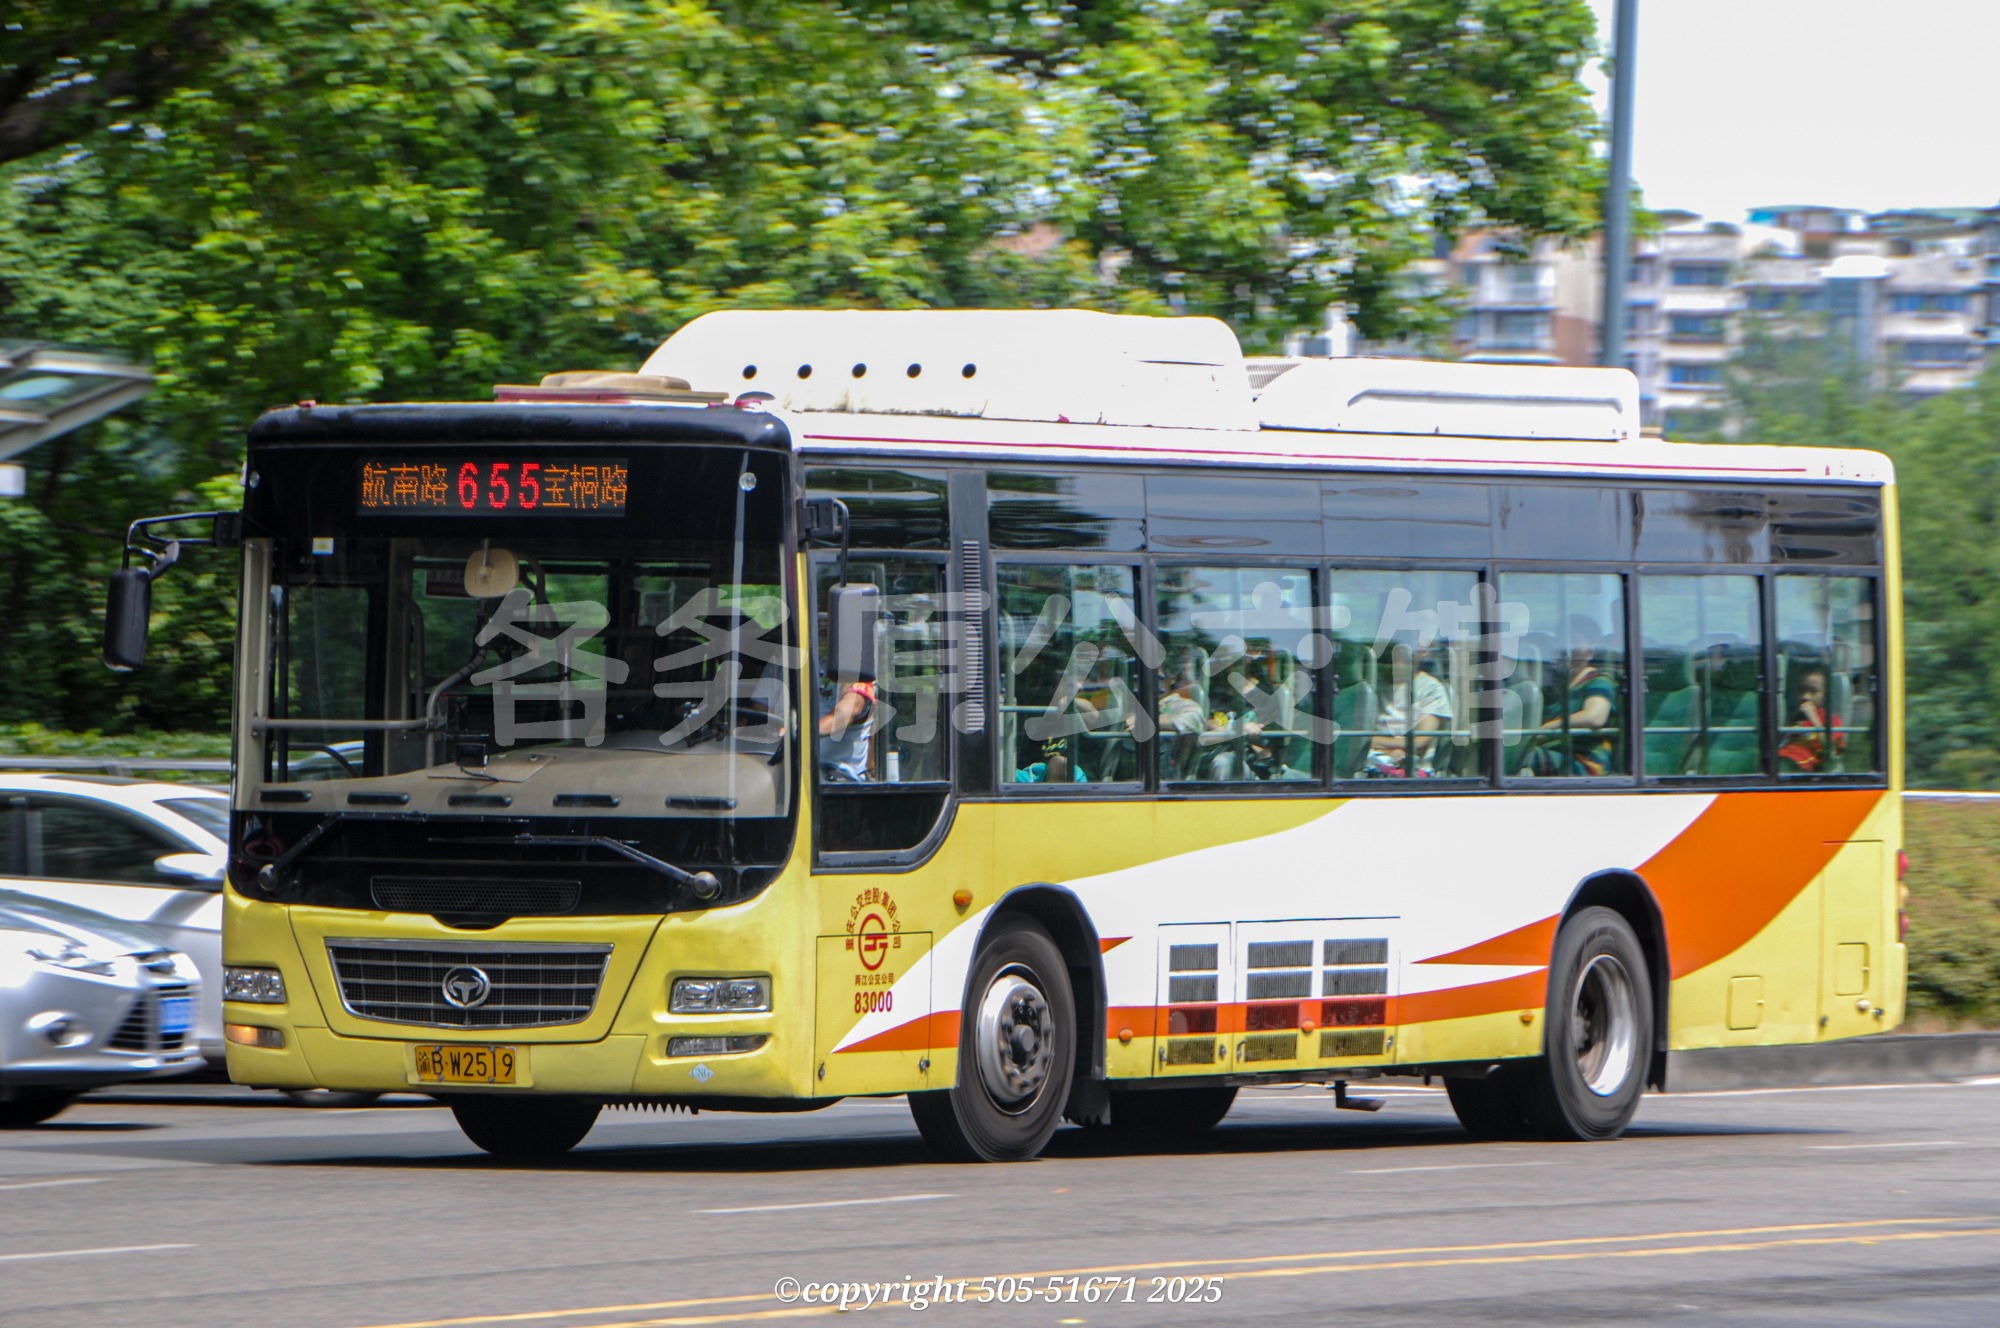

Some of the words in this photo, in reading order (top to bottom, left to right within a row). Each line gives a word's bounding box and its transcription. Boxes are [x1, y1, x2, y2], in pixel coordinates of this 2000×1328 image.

[363, 463, 448, 507] 航南路
[458, 462, 540, 508] 655
[543, 464, 628, 508] 宝桐路
[855, 973, 894, 986] 两江公交公司
[854, 990, 893, 1014] 83000
[690, 1067, 711, 1078] CNG
